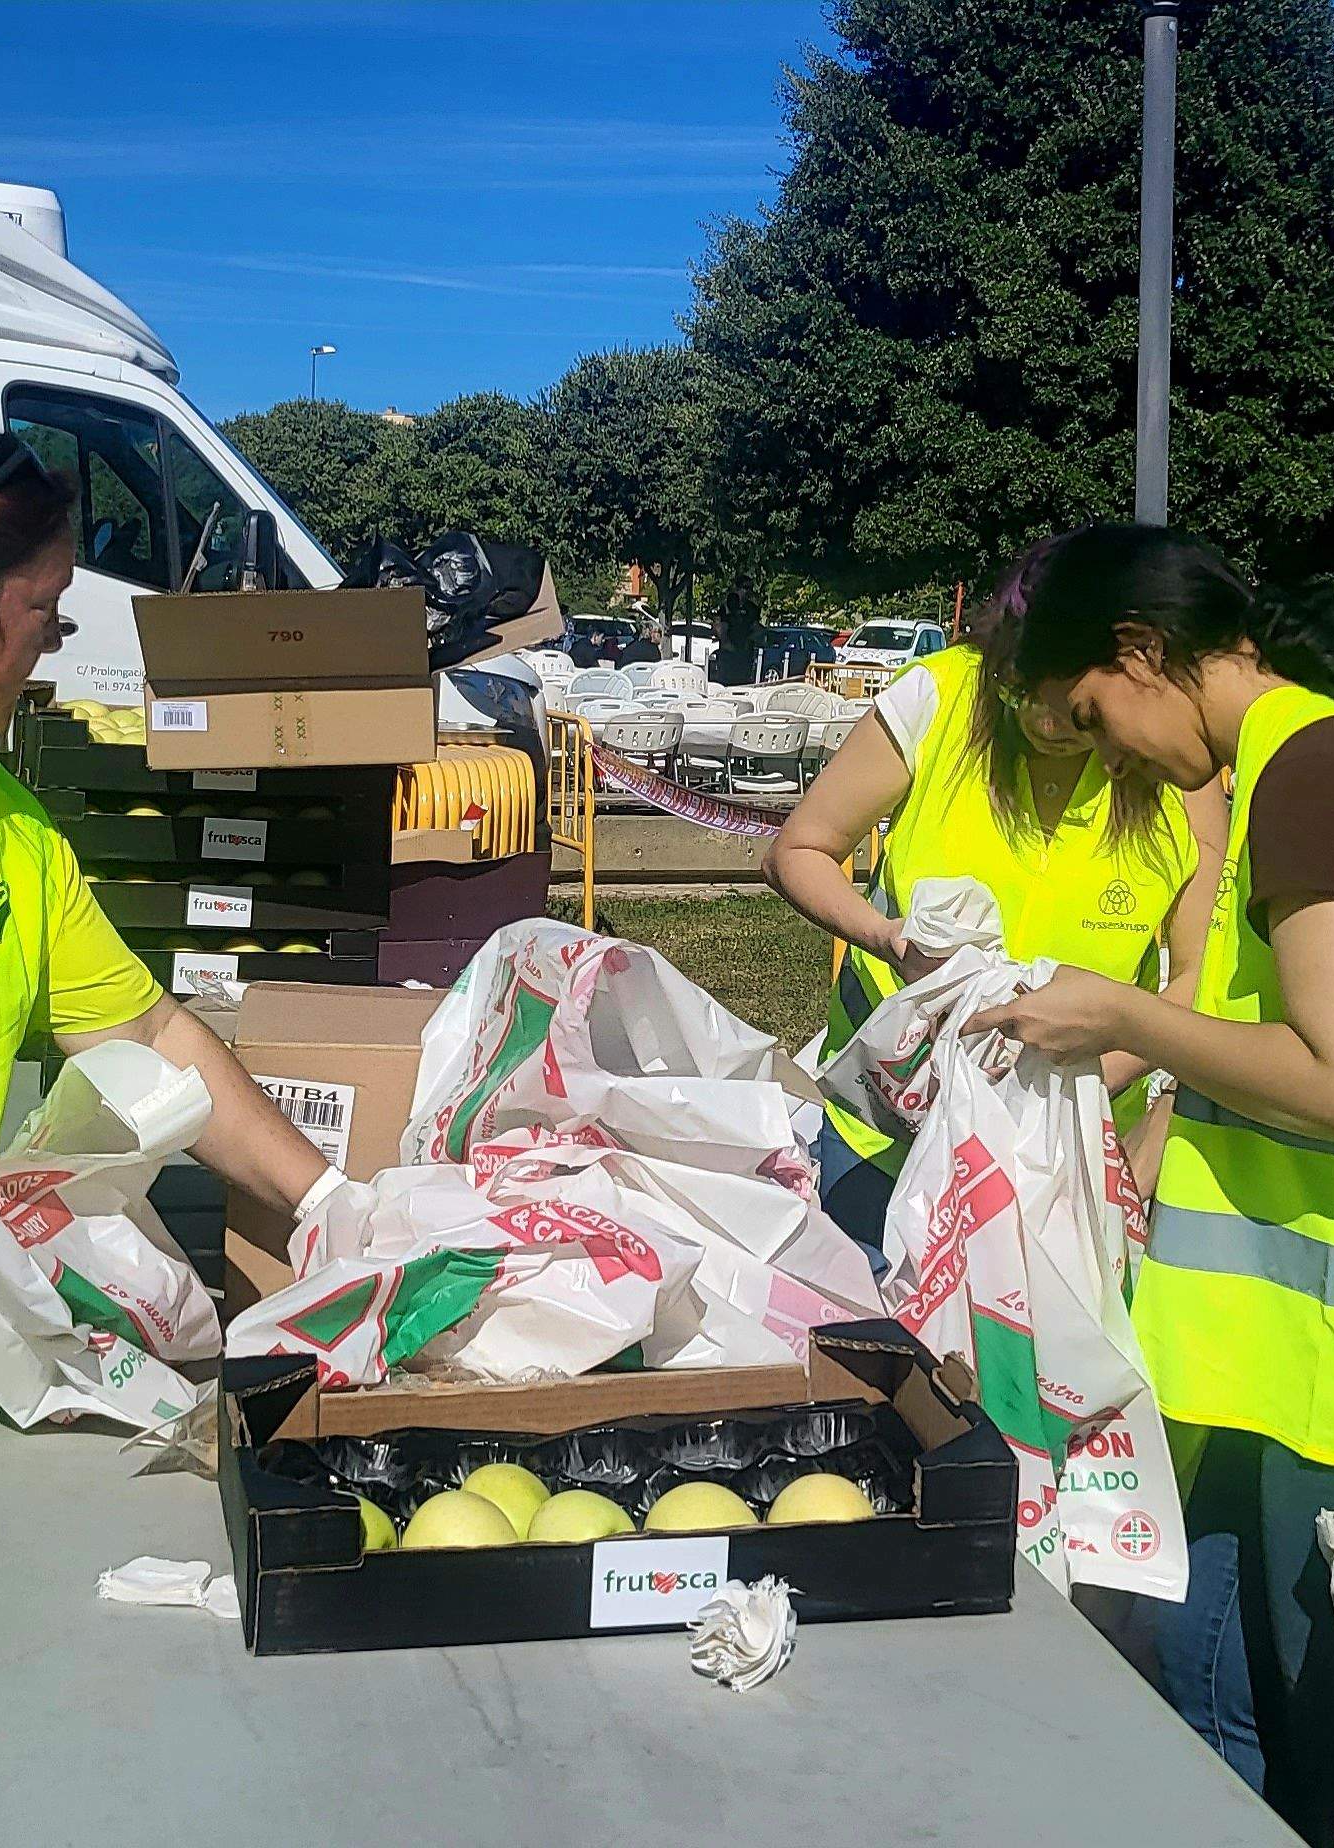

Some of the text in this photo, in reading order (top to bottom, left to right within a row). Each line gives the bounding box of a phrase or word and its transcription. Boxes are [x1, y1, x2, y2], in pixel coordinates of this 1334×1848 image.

[267, 630, 305, 643] 790
[112, 682, 131, 692] 974
[108, 1347, 147, 1389] 50%
